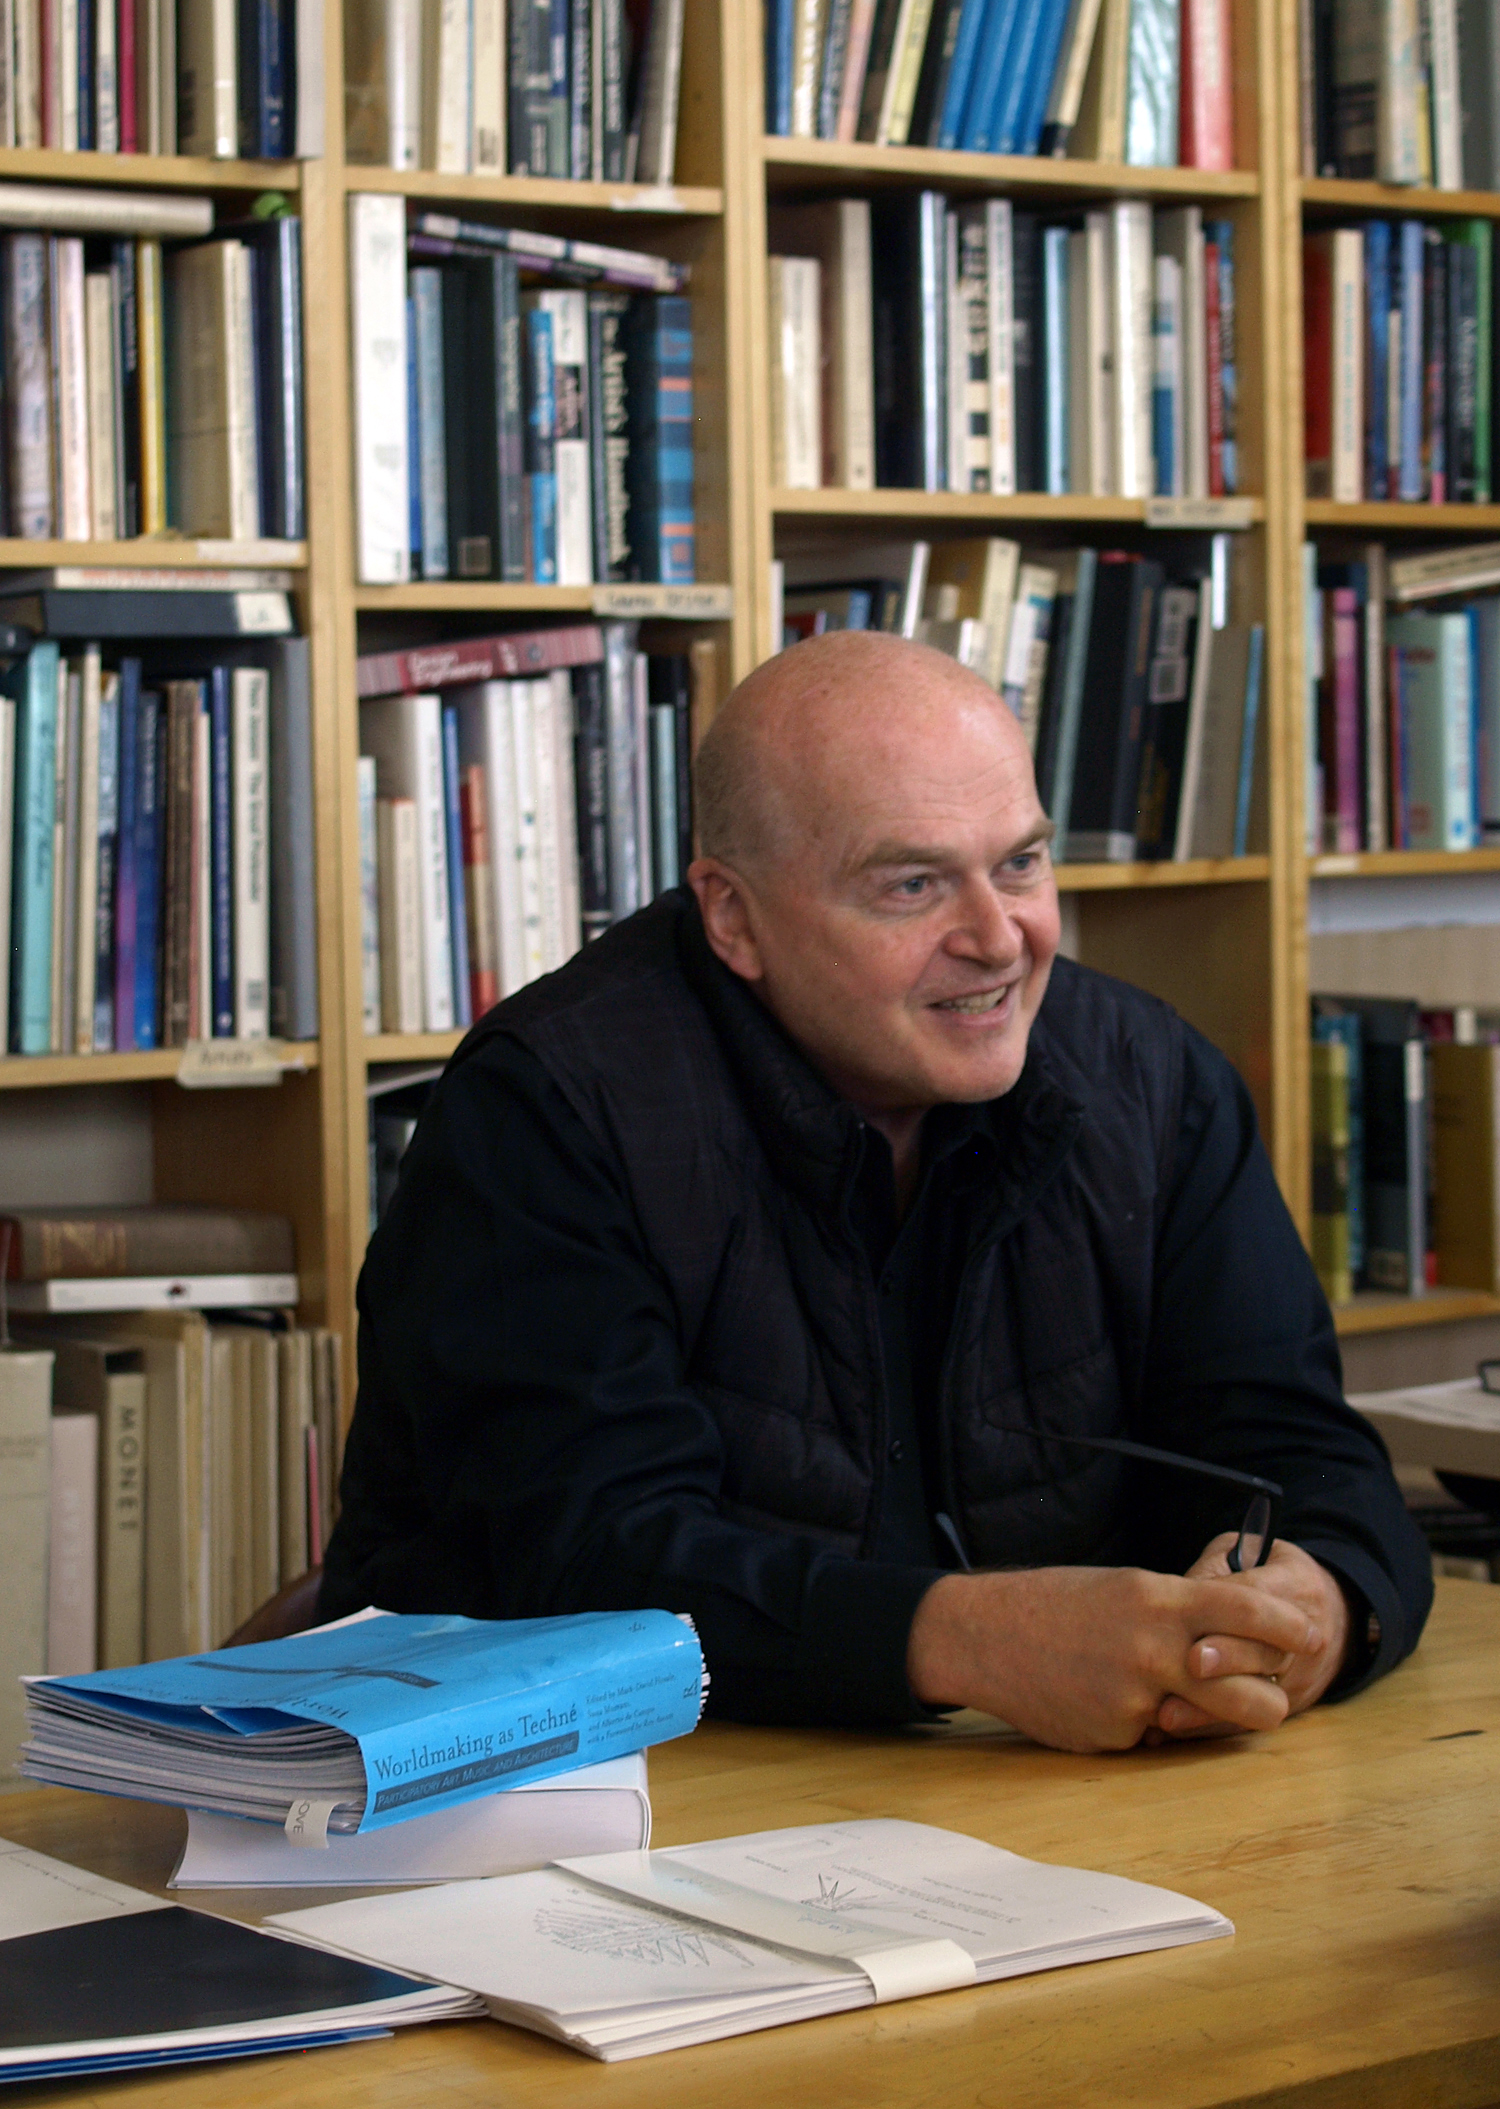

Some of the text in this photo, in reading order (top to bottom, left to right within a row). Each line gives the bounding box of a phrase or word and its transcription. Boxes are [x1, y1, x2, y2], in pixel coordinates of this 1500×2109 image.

[118, 1405, 140, 1531] MONET
[373, 1703, 578, 1780] Worldmaking as Techné
[293, 1800, 311, 1834] OVE
